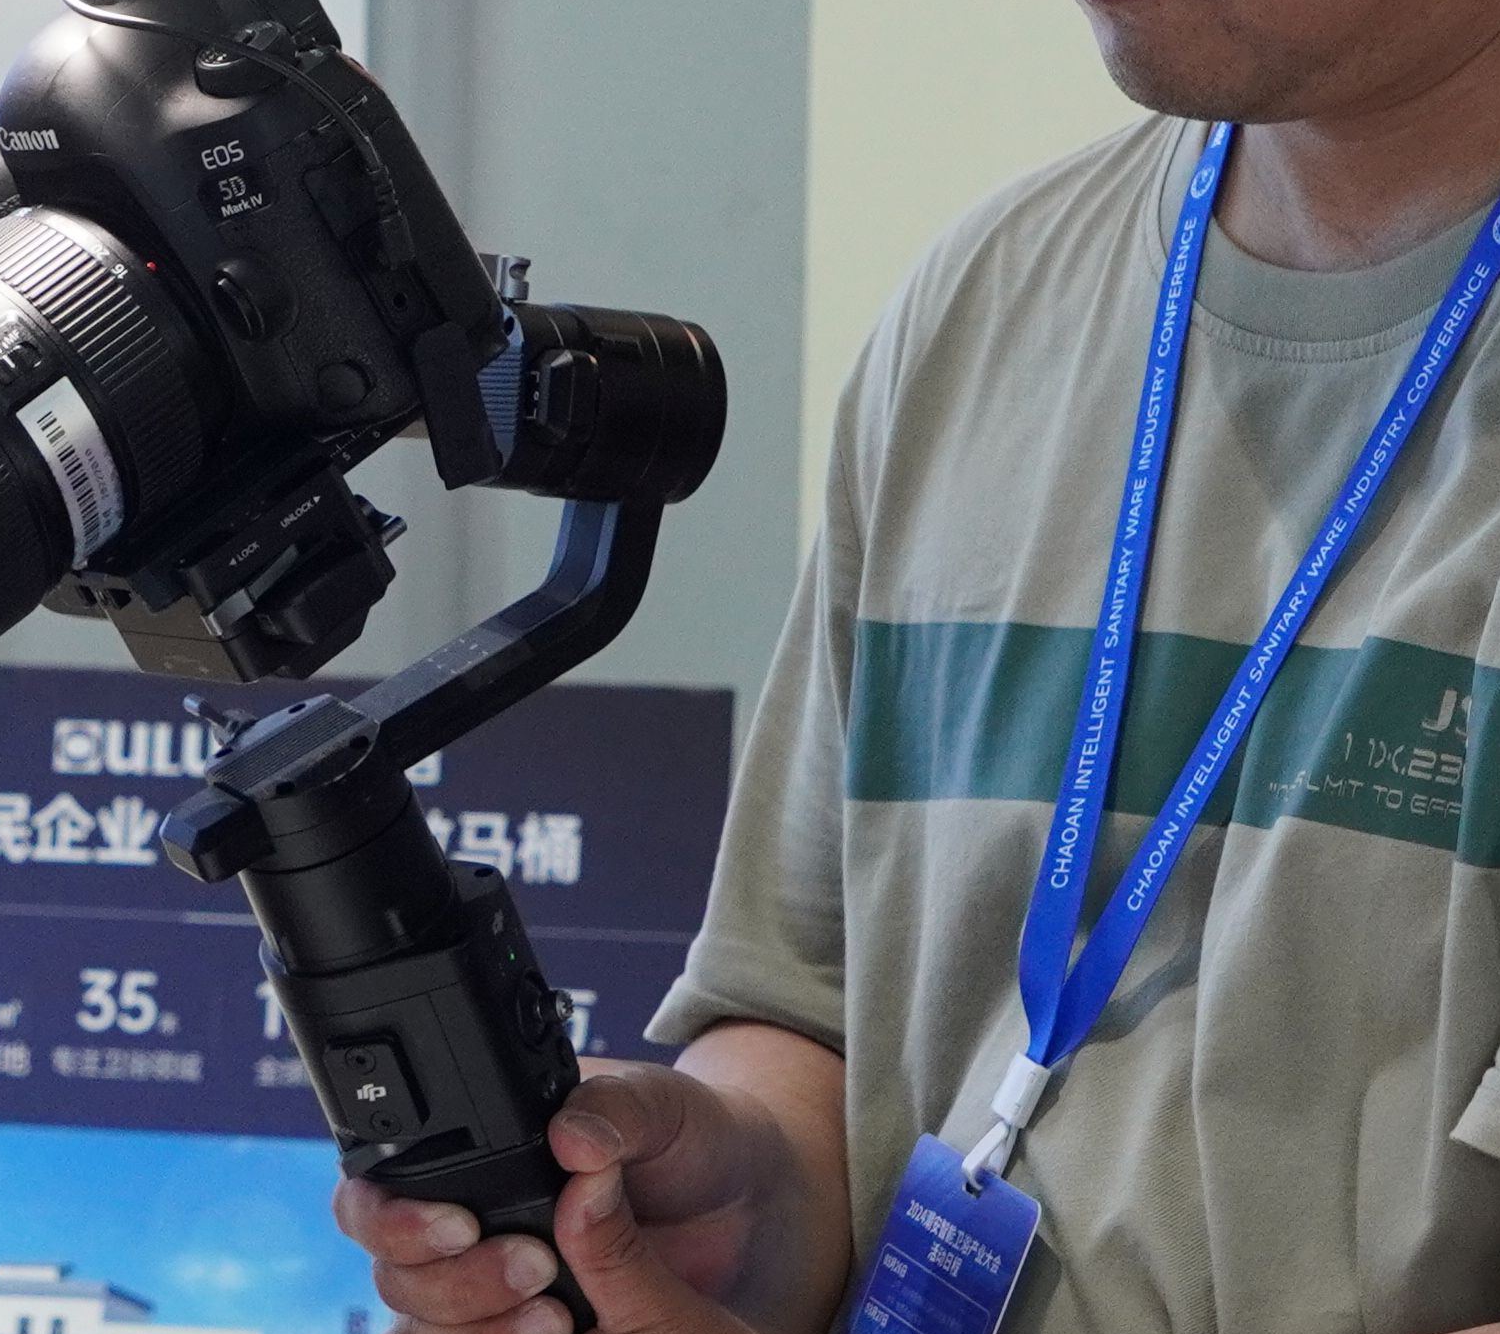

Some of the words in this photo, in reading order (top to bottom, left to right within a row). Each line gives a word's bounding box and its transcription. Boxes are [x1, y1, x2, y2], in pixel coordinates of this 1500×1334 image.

[201, 140, 244, 170] EOS
[218, 175, 246, 201] 5D
[220, 199, 251, 217] Mark
[249, 193, 263, 207] IV
[111, 263, 128, 279] 16
[280, 500, 314, 528] UNLOCK
[236, 541, 260, 561] LOCK
[1051, 797, 1085, 889] CHAOAN
[1073, 656, 1116, 791] INTELLIGENT
[1104, 546, 1134, 648] SANITARY
[1124, 476, 1147, 540] WARE
[1137, 366, 1167, 471] INDUSTRY
[1158, 216, 1197, 358] CONFERENCE
[1127, 820, 1180, 912] CHAOAN
[1175, 685, 1252, 819] INTELLIGENT
[1249, 585, 1308, 684] SANITARY
[1306, 517, 1347, 577] WARE
[1344, 408, 1408, 514] INDUSTRY
[1406, 262, 1490, 405] CONFERENCE
[1373, 784, 1403, 809] TO
[426, 808, 583, 885] 马桶
